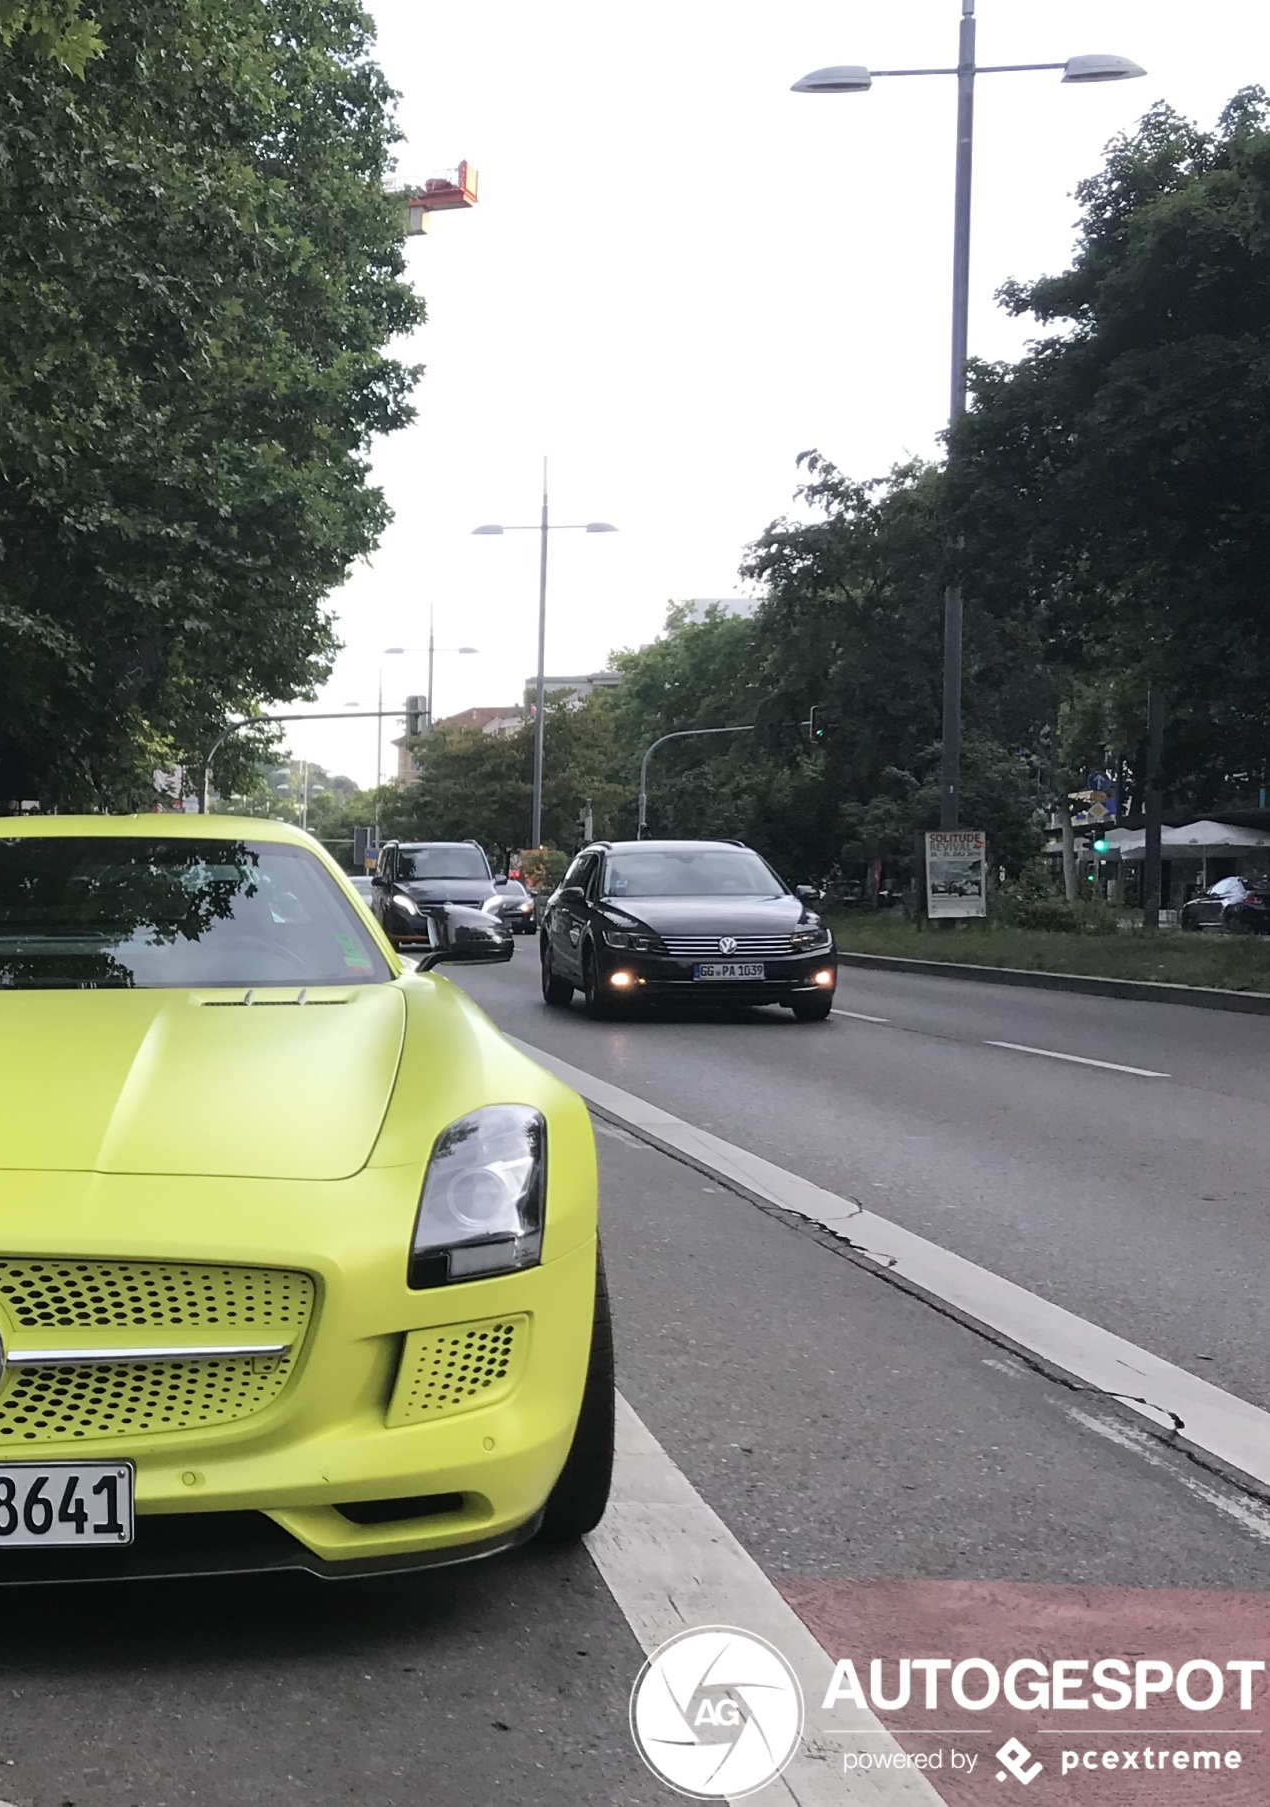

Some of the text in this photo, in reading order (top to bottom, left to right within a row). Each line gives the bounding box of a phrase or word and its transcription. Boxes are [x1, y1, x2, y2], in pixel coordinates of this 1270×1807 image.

[930, 833, 981, 842] SOLITUDE
[930, 843, 972, 851] REVIVAL
[700, 965, 763, 976] GG PA 1039
